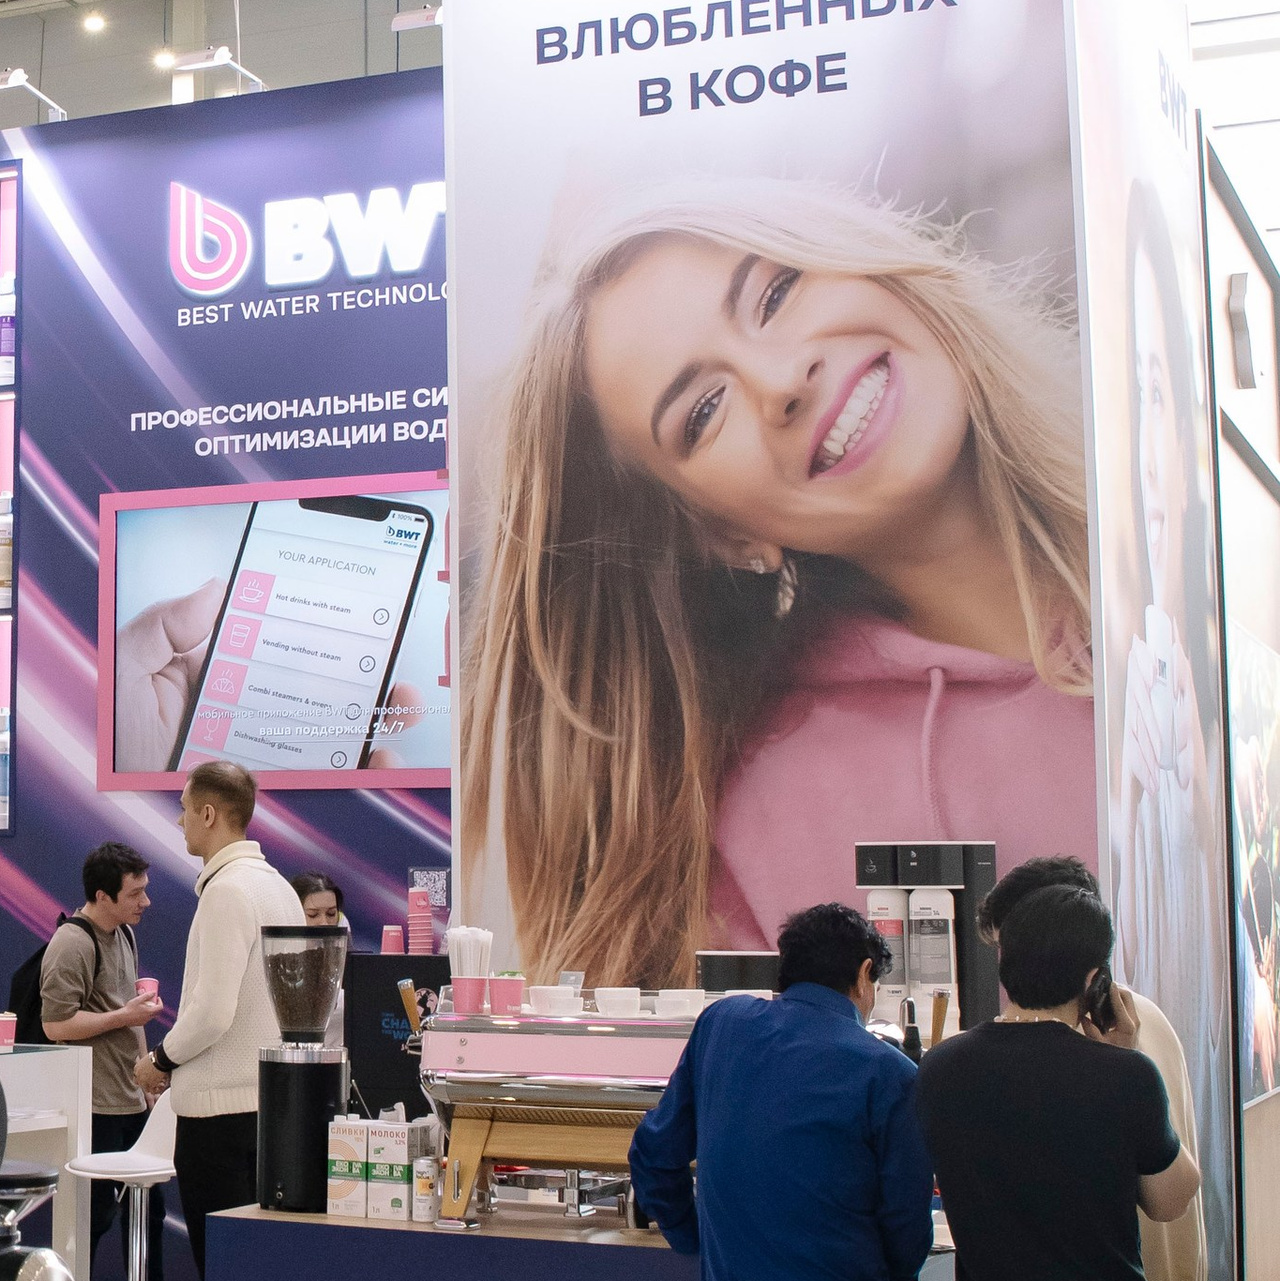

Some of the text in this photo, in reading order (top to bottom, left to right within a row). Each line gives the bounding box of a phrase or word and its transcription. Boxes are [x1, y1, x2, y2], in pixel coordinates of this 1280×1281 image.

[639, 52, 848, 117] В КОФЕ
[178, 304, 233, 326] BEST
[241, 294, 320, 320] WATER
[130, 389, 407, 431] ПРОФЕССИОНАЛЬНЫЕ
[195, 423, 386, 456] ОПТИМИЗАЦИИ
[396, 529, 420, 541] BWT
[278, 550, 376, 576] YOUR APPLICATION
[276, 593, 351, 614] Hot drinks with steam
[262, 638, 342, 662] Vending without steam
[248, 684, 271, 696] Combi
[272, 691, 303, 704] steamers
[197, 708, 255, 721] мобильное
[257, 708, 322, 720] приложение
[259, 722, 405, 737] ваша поддержка 24/7
[277, 741, 302, 754] glasses
[331, 1126, 365, 1136] СЛИВКИ
[370, 1130, 406, 1139] МОЛОКО
